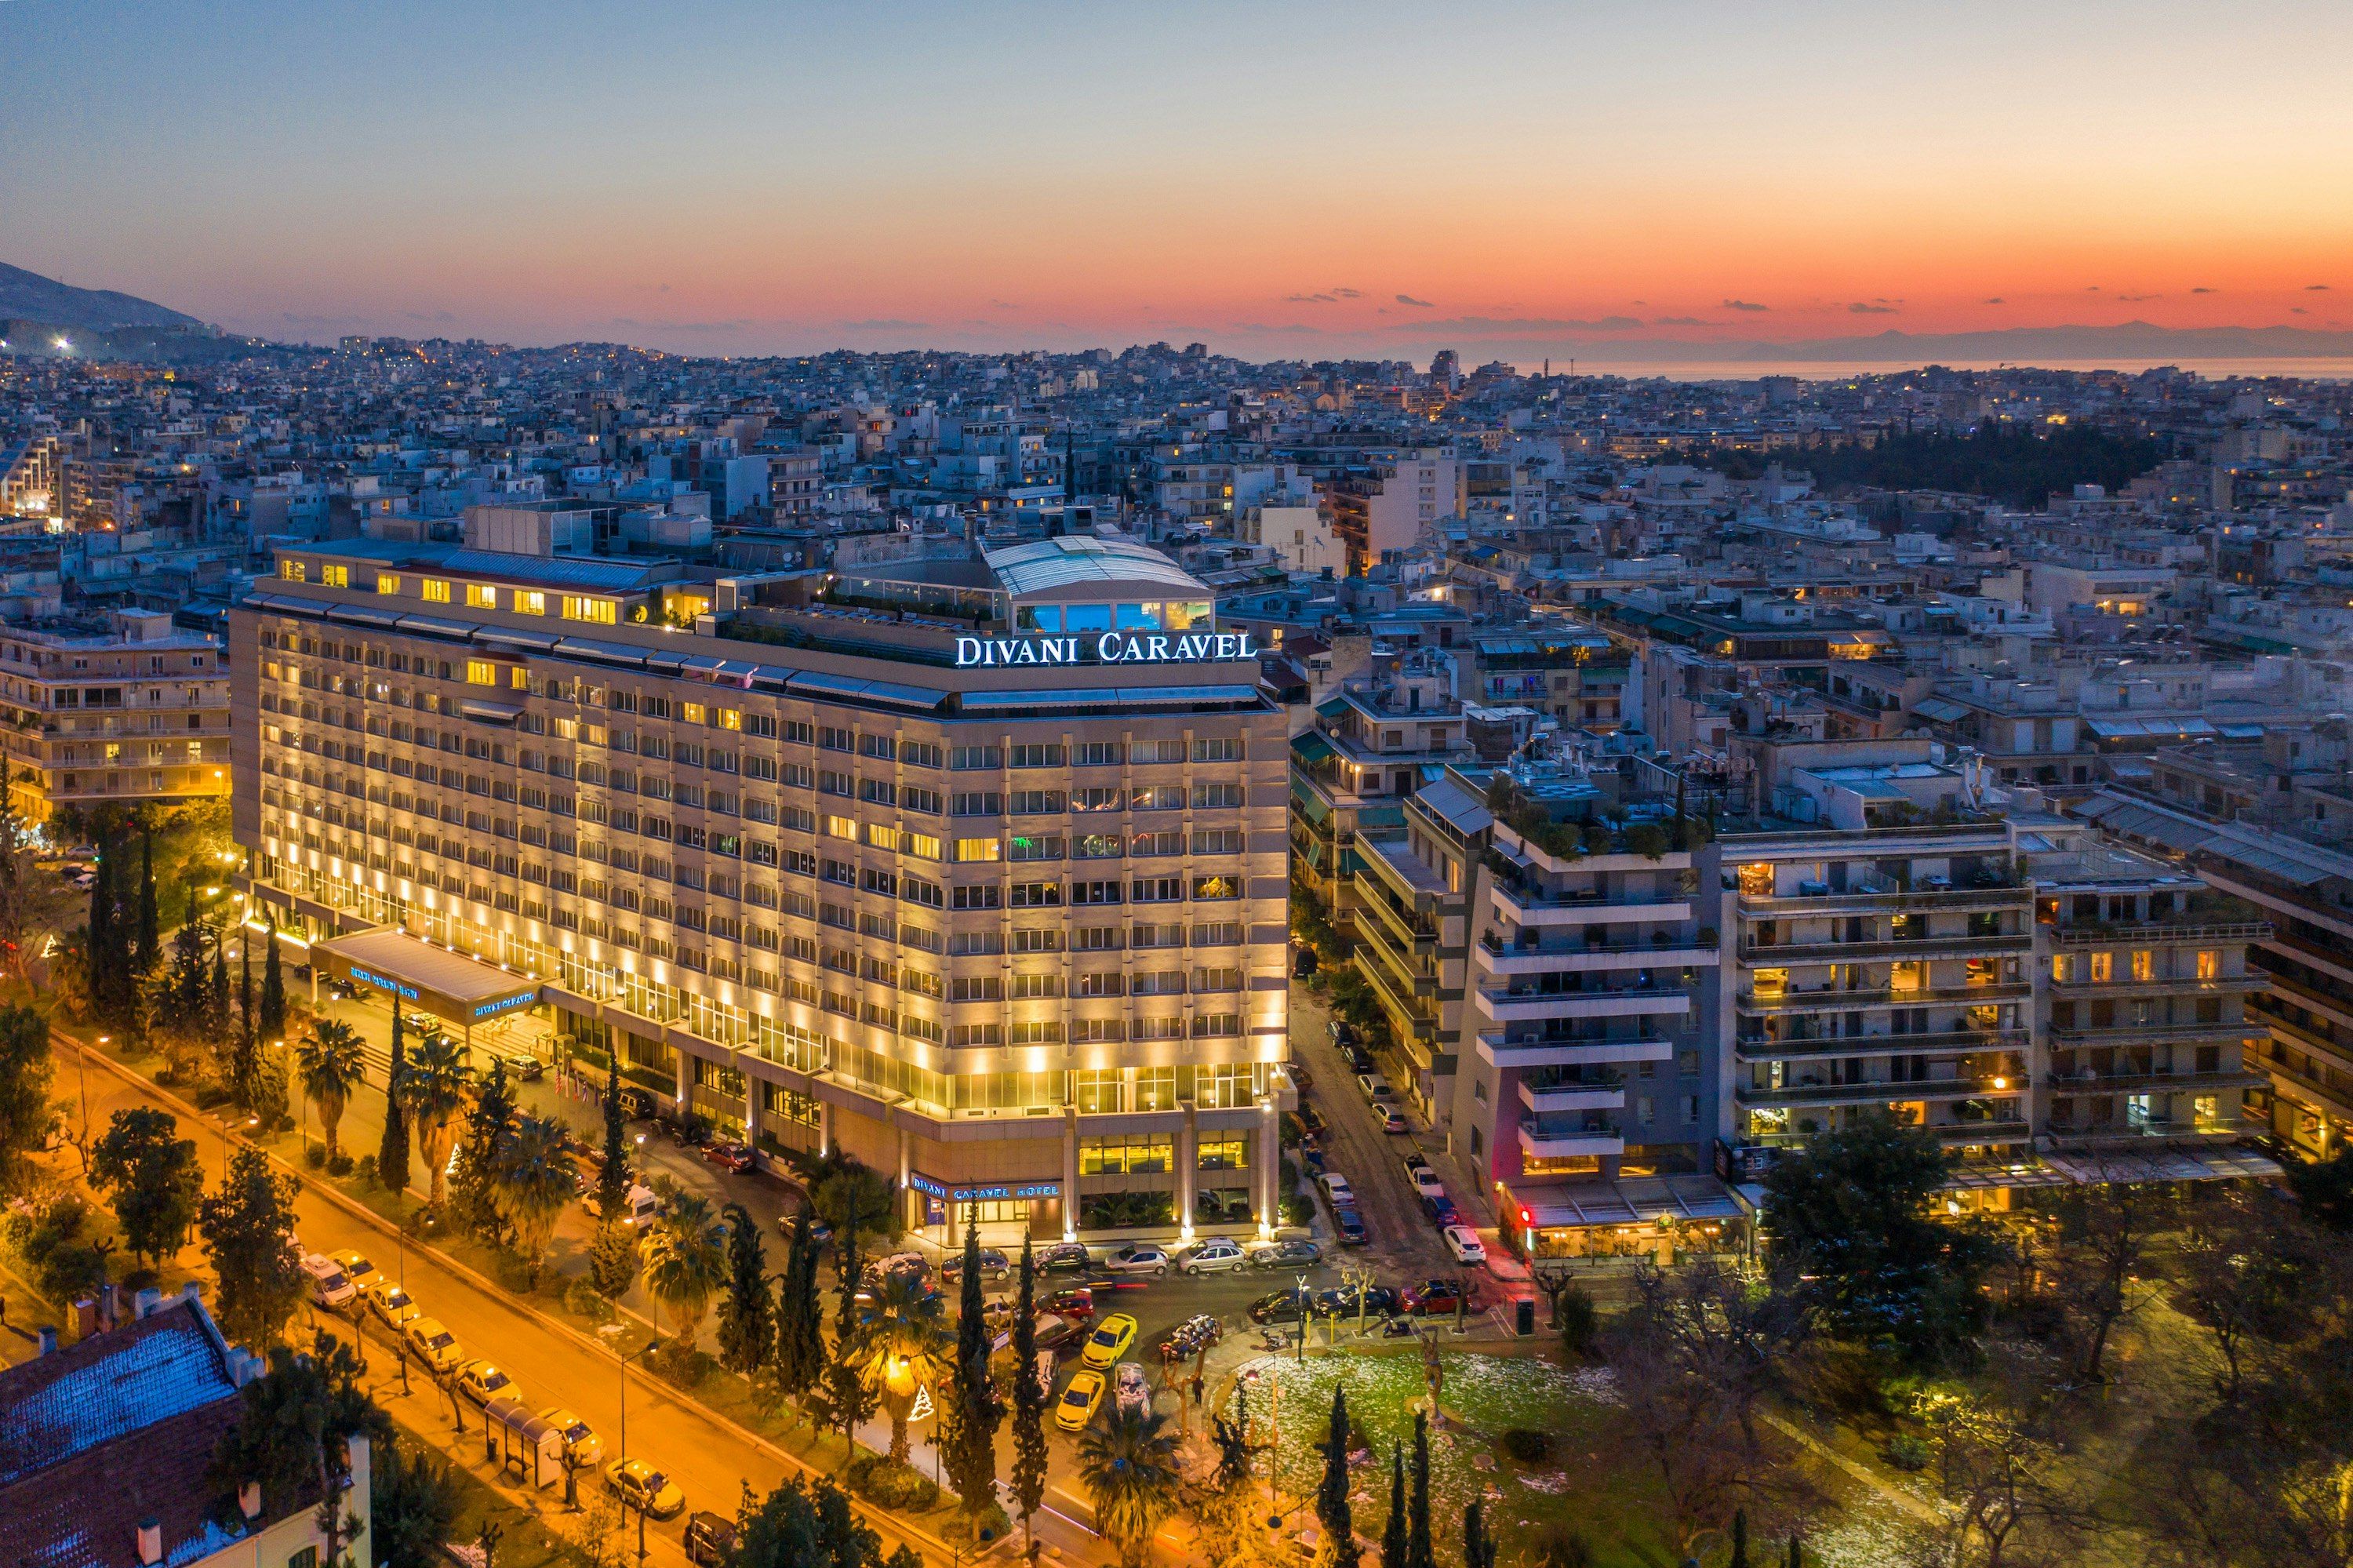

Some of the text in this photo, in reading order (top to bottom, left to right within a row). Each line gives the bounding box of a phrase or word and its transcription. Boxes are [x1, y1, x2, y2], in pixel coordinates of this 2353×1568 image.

[955, 632, 1258, 665] DIVANI CARAVEL
[914, 1177, 946, 1199] DIVANI
[1016, 1185, 1059, 1197] HOTEL
